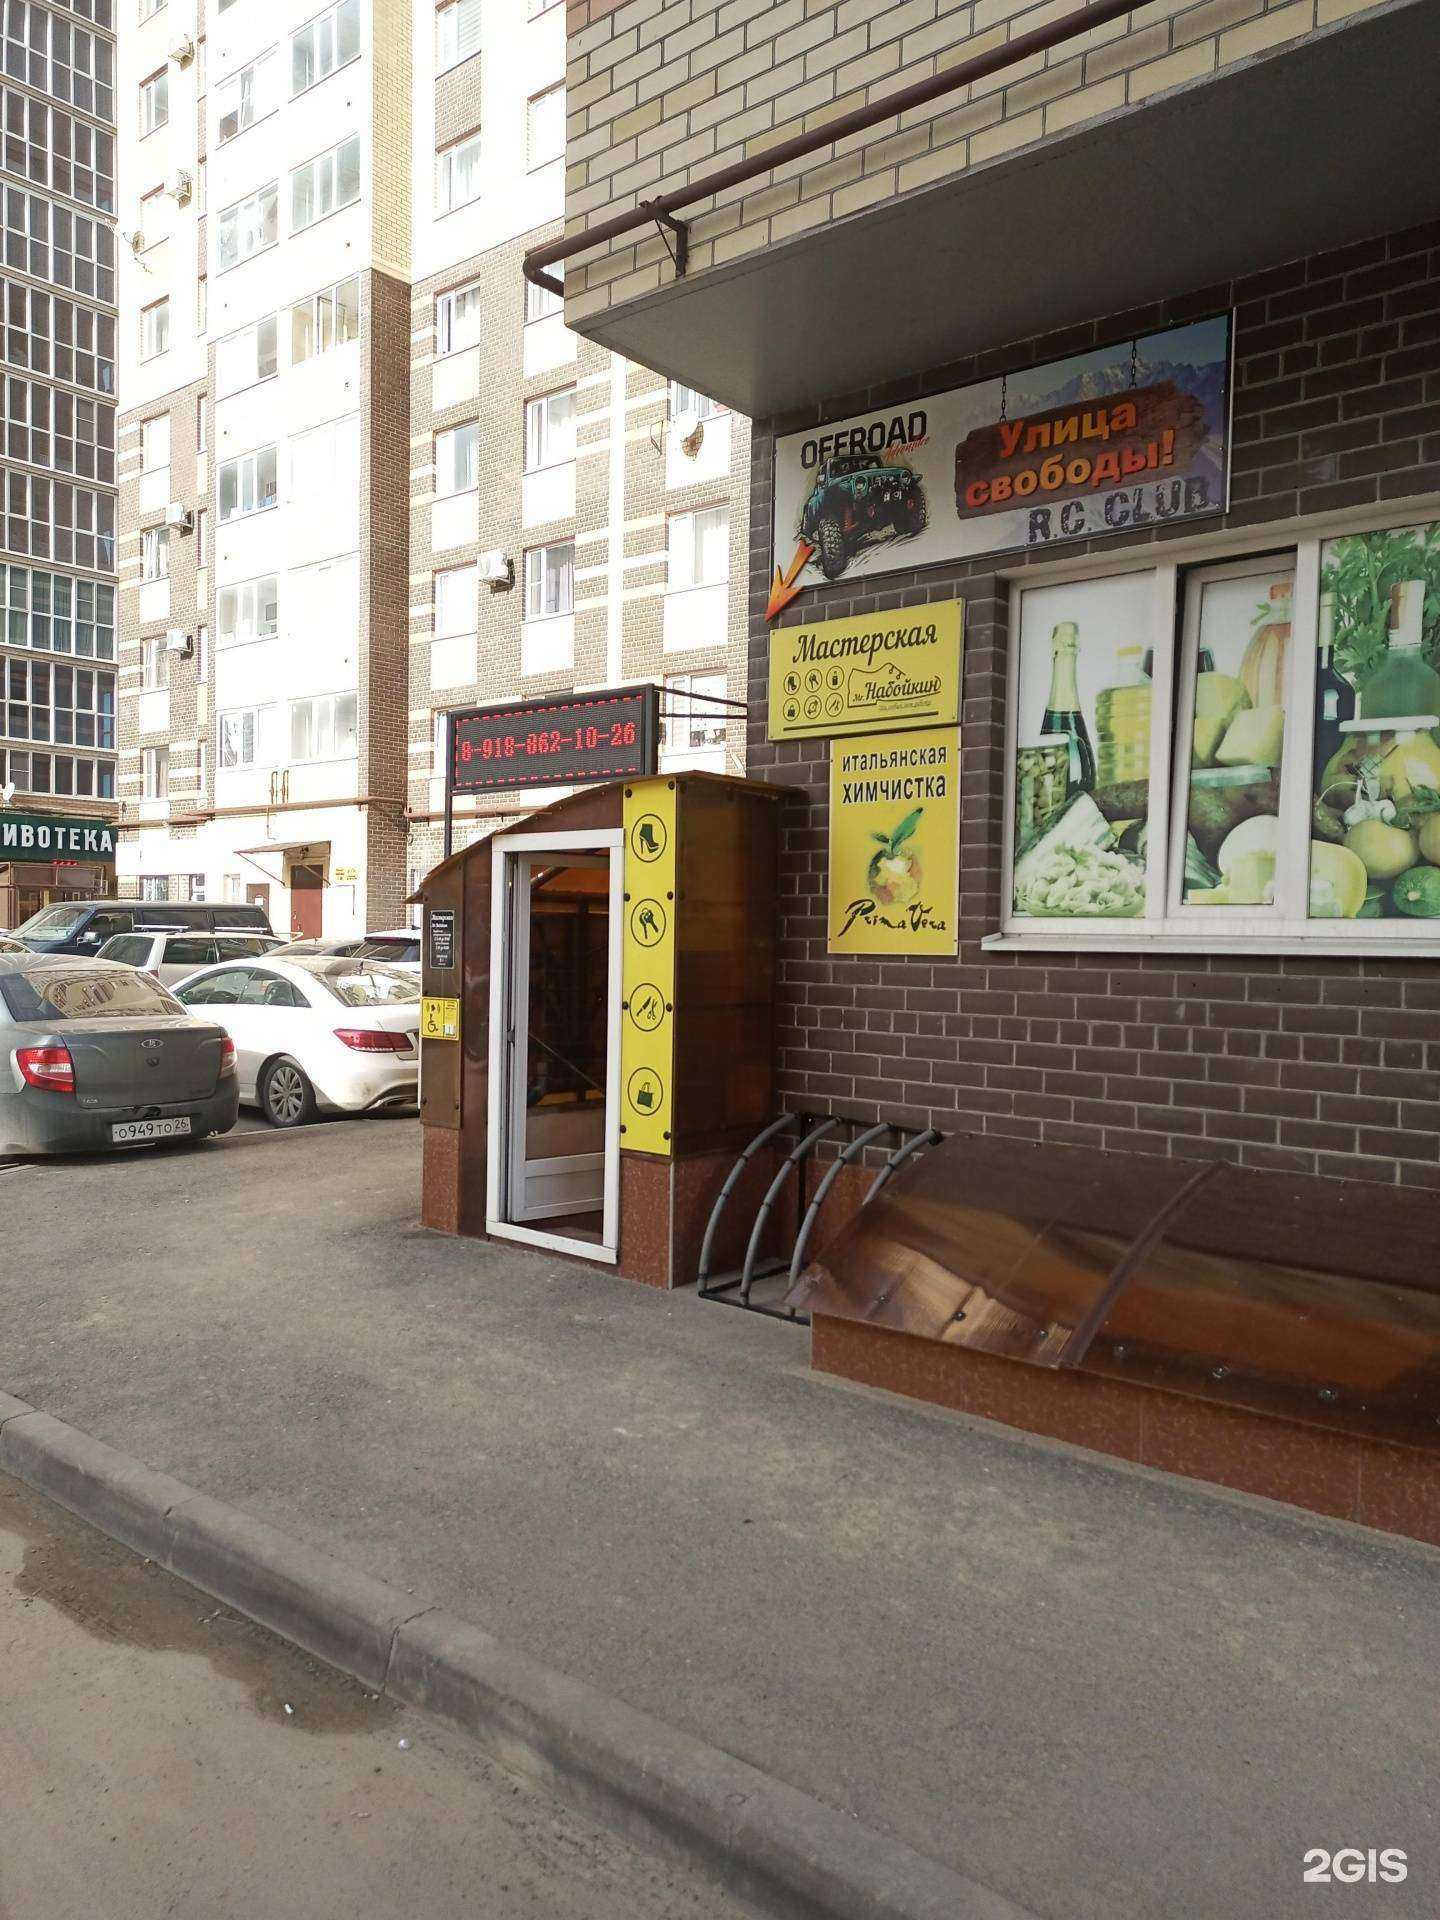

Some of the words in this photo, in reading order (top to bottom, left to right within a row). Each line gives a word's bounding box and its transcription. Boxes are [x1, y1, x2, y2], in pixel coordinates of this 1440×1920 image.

[800, 410, 928, 470] OFFROAD
[999, 401, 1138, 458] Улица
[965, 426, 1176, 508] свободы!
[1104, 475, 1211, 527] CLUB
[792, 623, 938, 666] Мастерская
[865, 675, 942, 700] Набойкин
[842, 746, 947, 773] итальянская
[905, 900, 947, 932] Vera
